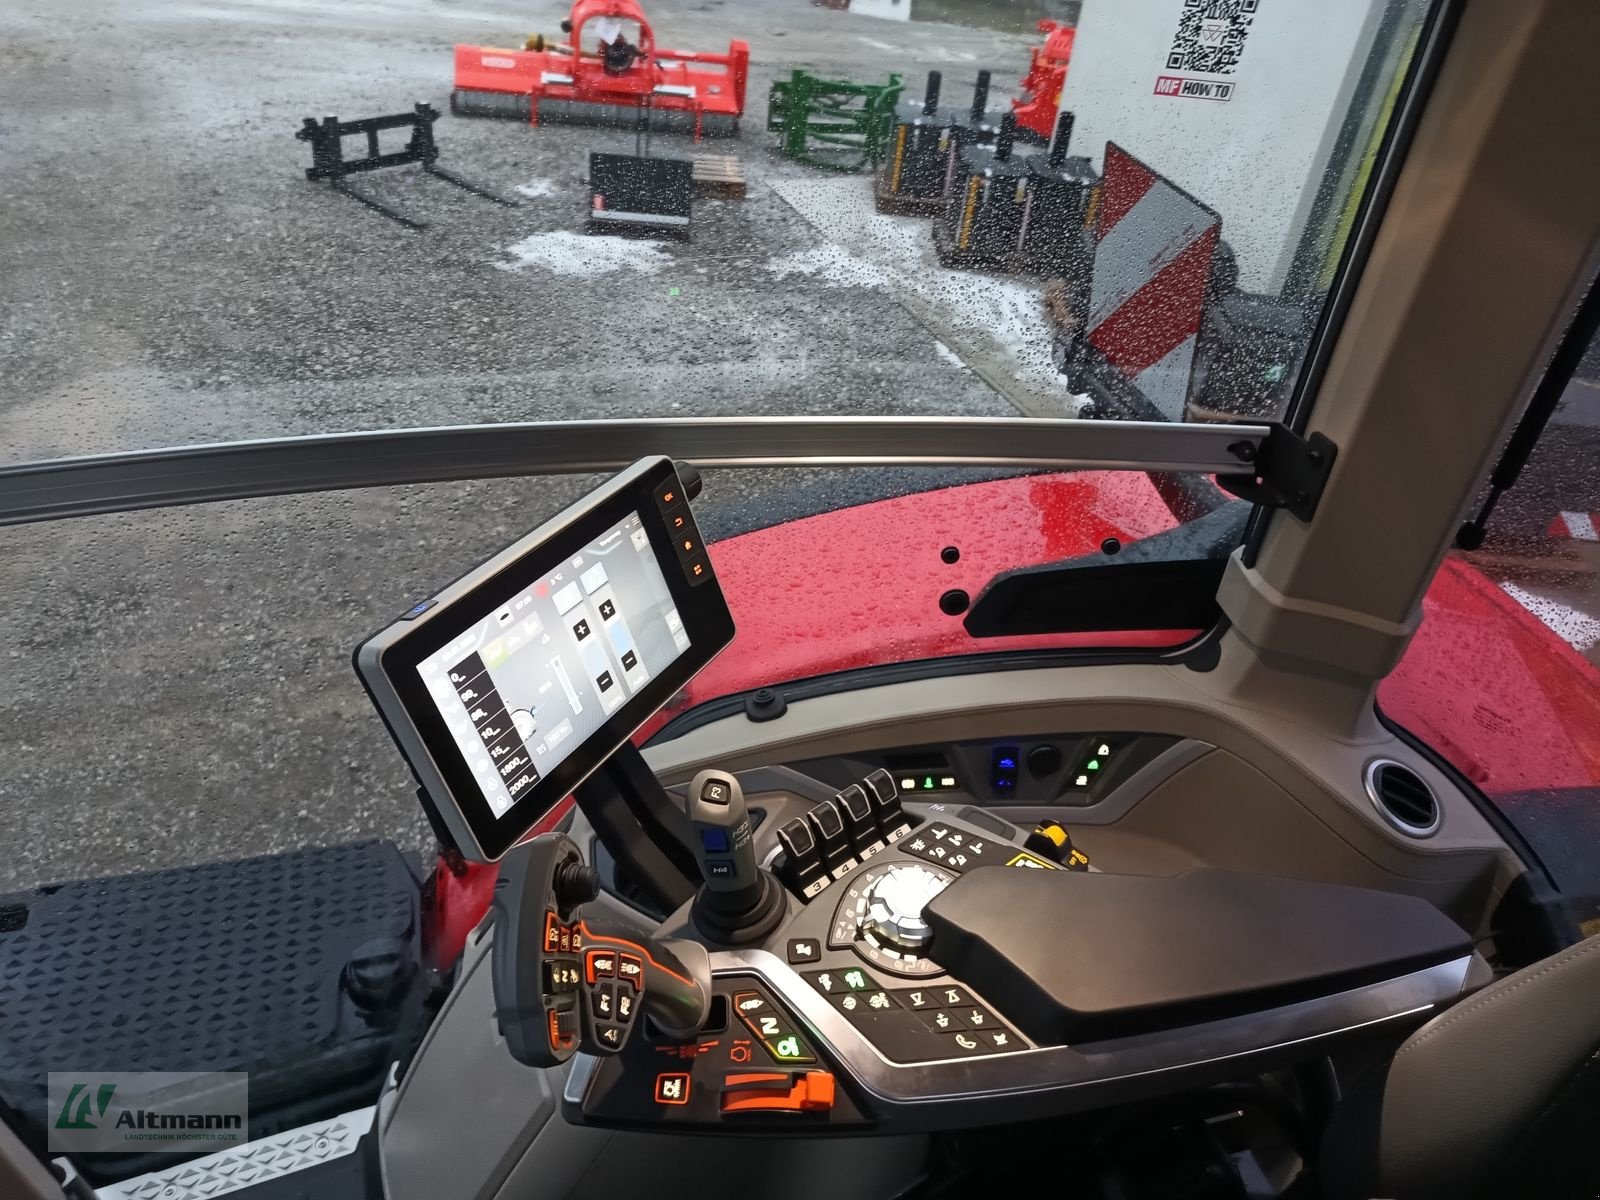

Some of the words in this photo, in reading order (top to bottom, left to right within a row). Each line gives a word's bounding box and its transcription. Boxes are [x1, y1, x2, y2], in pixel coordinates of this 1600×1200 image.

[1156, 79, 1179, 94] MF
[1181, 81, 1213, 96] HOW
[1214, 84, 1230, 98] TO
[509, 775, 529, 795] 2000
[711, 787, 721, 799] F3
[760, 1017, 780, 1034] N
